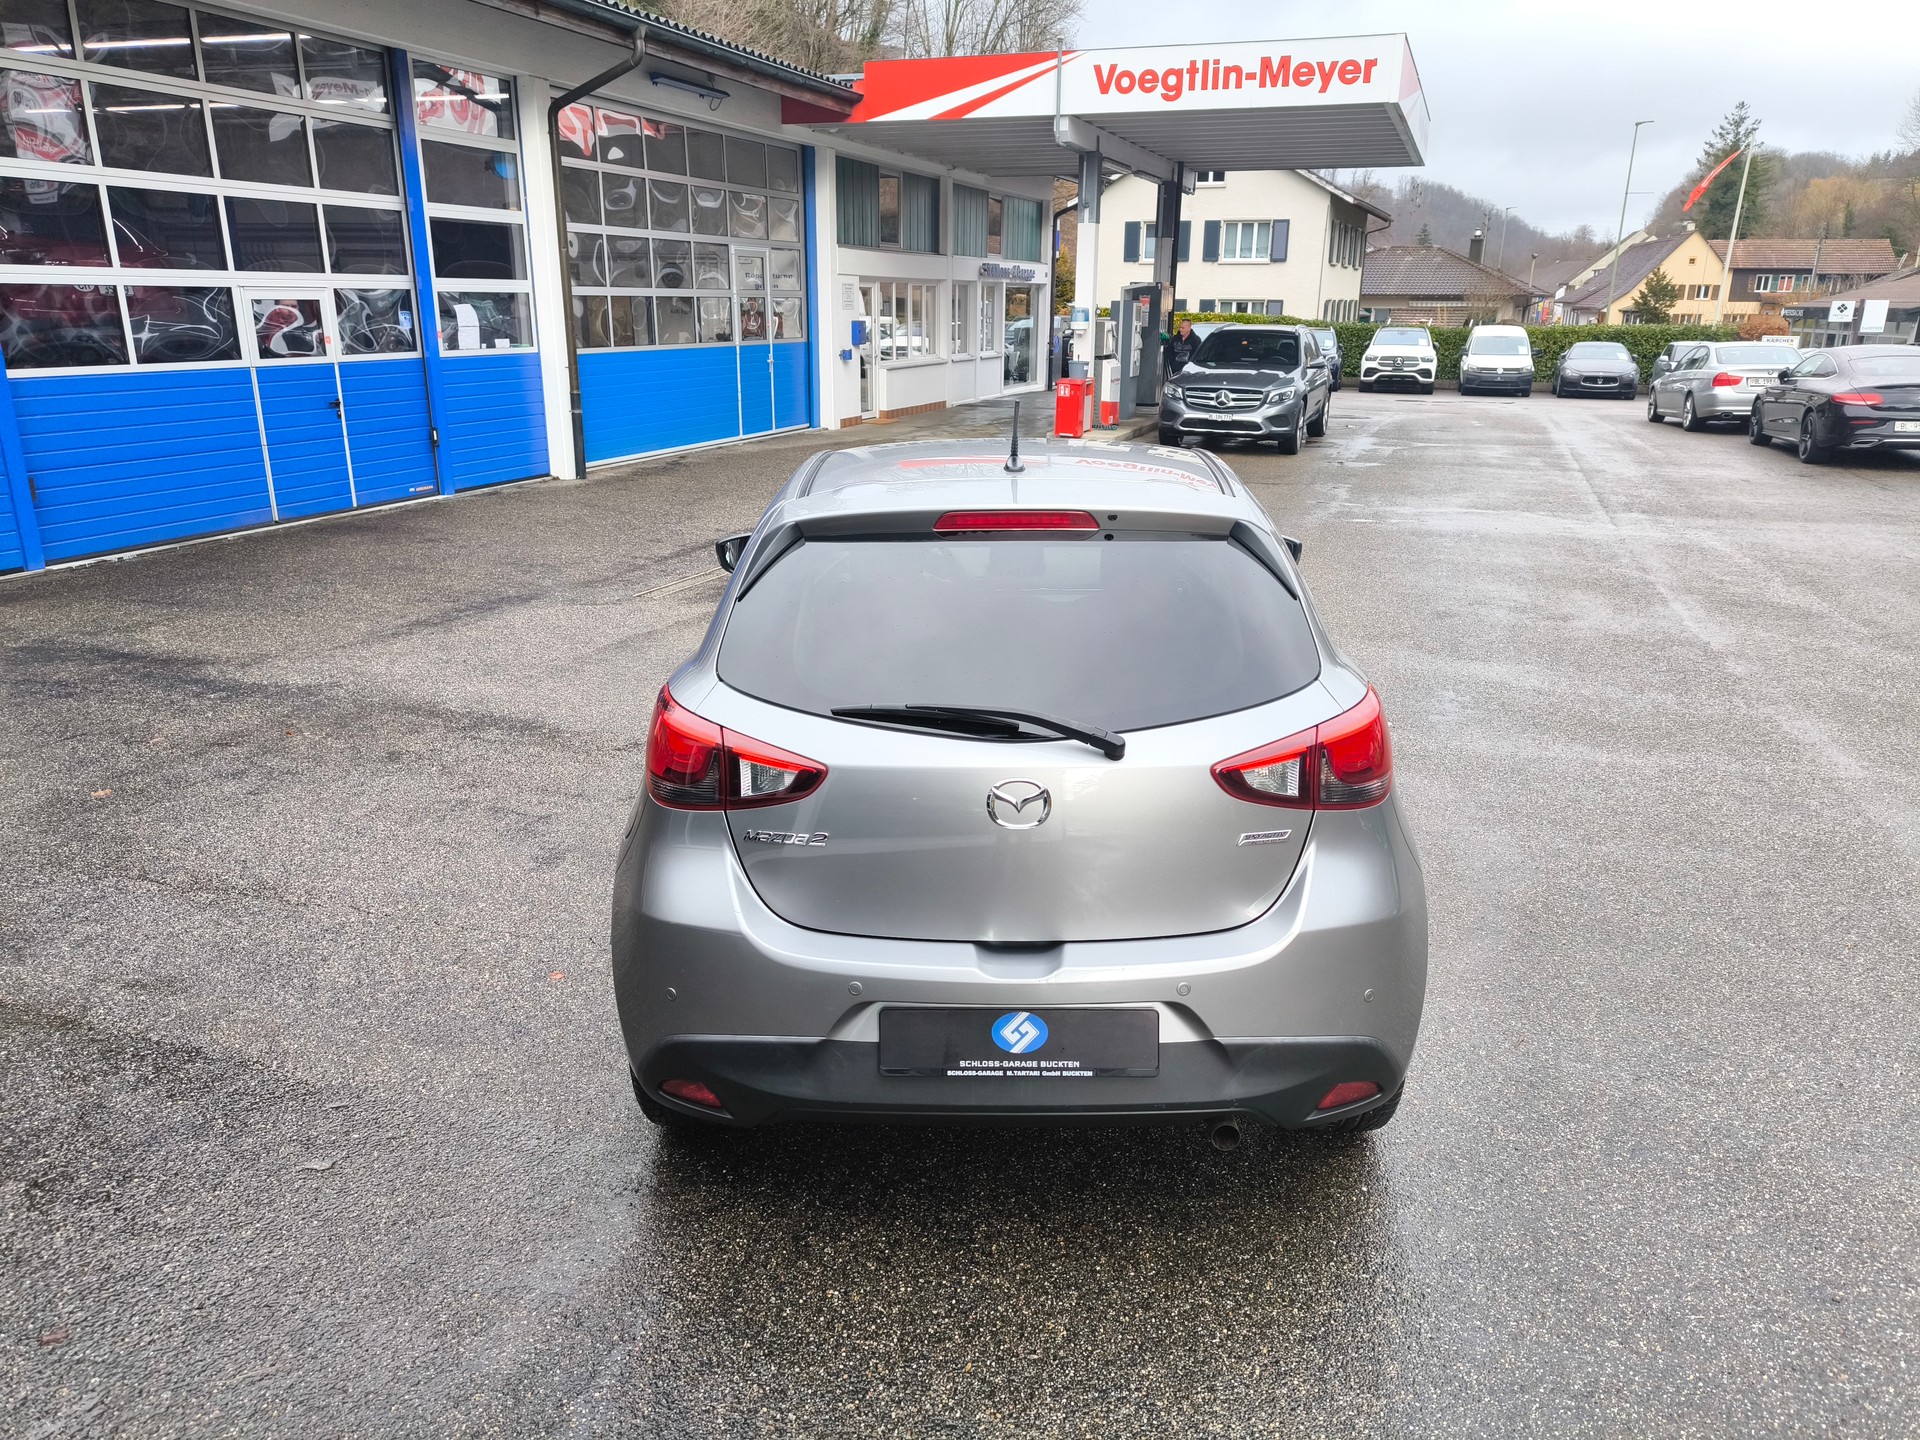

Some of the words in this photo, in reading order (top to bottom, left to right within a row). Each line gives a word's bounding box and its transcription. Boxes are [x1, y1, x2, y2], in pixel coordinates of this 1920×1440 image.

[1093, 55, 1378, 102] Voegtlin-Meyer
[959, 1060, 1038, 1068] SCHLOSS-GARAGE
[1040, 1060, 1080, 1068] BUCKTEN
[946, 1069, 1004, 1077] SCHLOSS-GARAGE
[1006, 1069, 1040, 1077] M.TARTARI
[1042, 1069, 1061, 1077] GmbH
[1062, 1069, 1093, 1077] BUCKTEN
